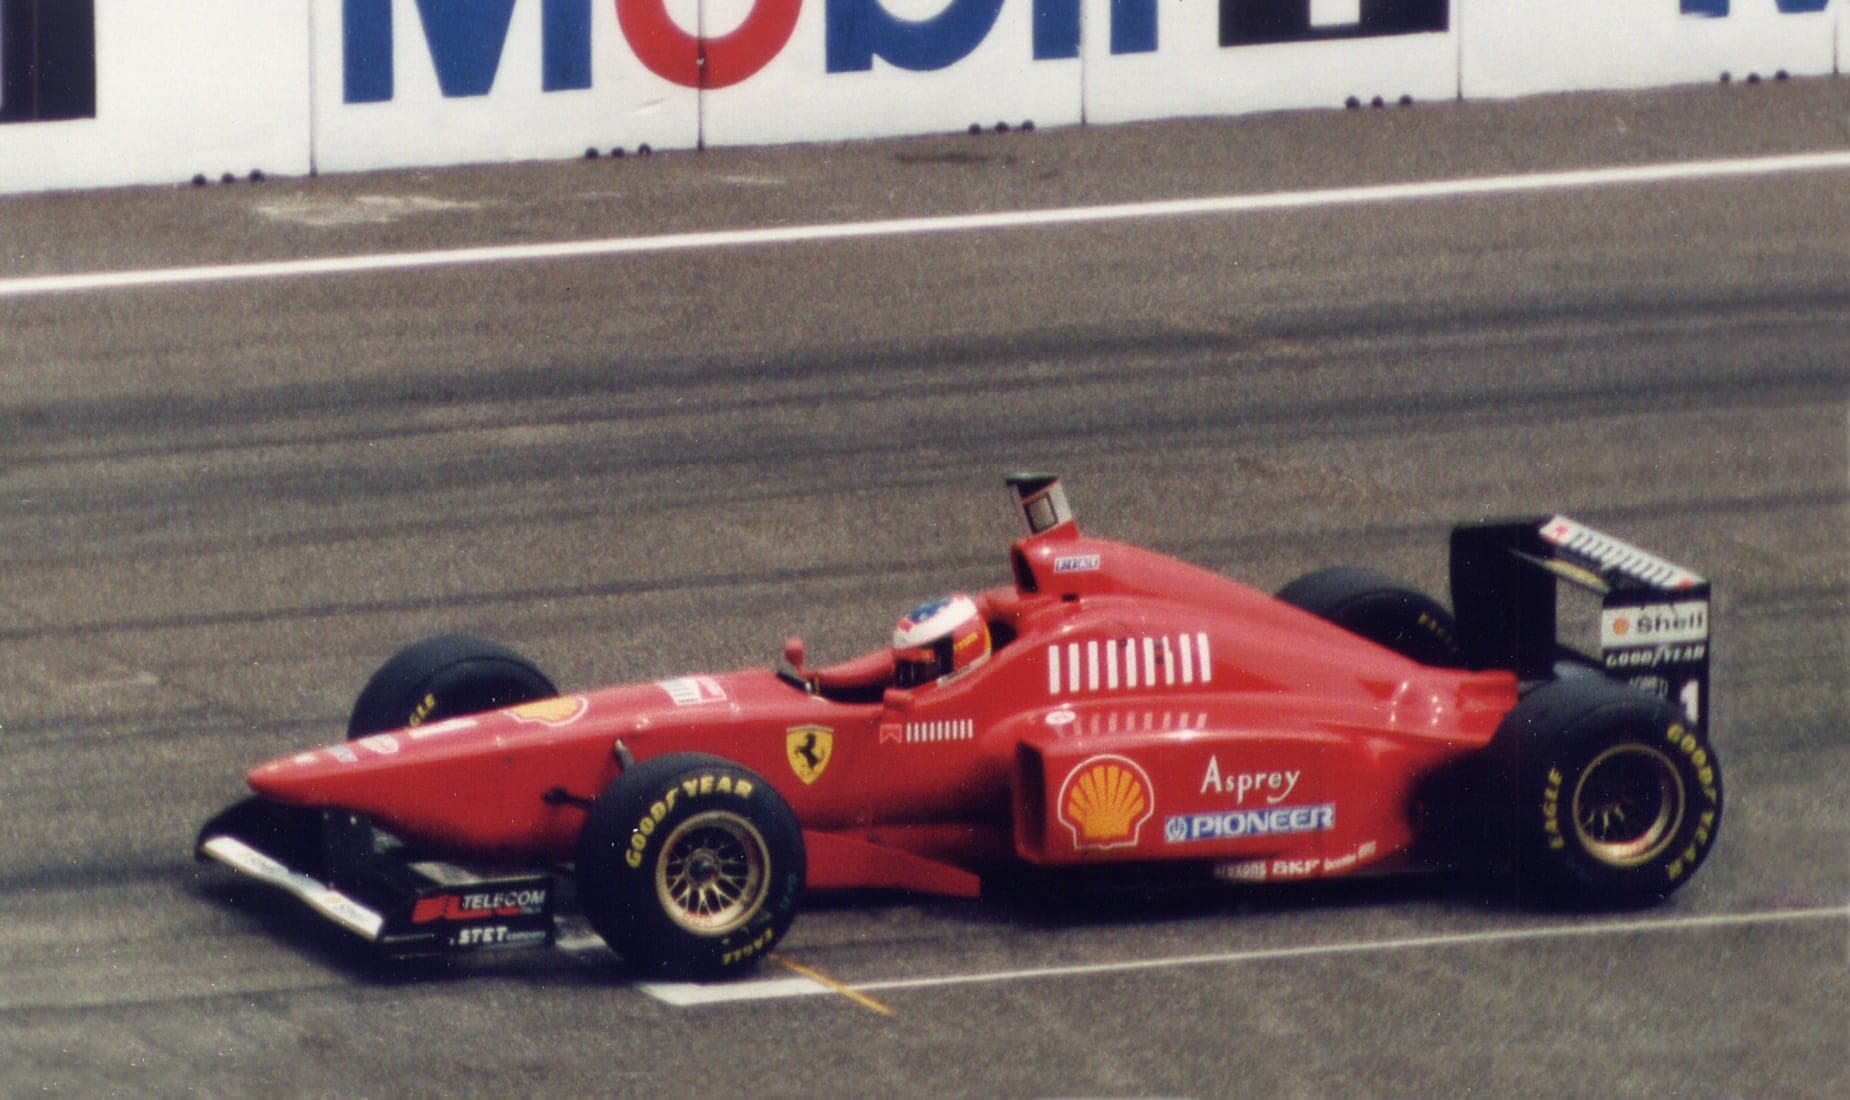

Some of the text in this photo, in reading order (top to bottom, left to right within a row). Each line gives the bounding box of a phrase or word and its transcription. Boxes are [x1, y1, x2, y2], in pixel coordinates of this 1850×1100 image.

[1637, 611, 1703, 633] Shell
[409, 693, 436, 726] GLE
[1200, 754, 1301, 804] Asprey
[1191, 806, 1334, 838] PIONEER
[1272, 858, 1321, 876] SKF
[463, 889, 546, 910] TELECOM
[458, 925, 508, 946] STET
